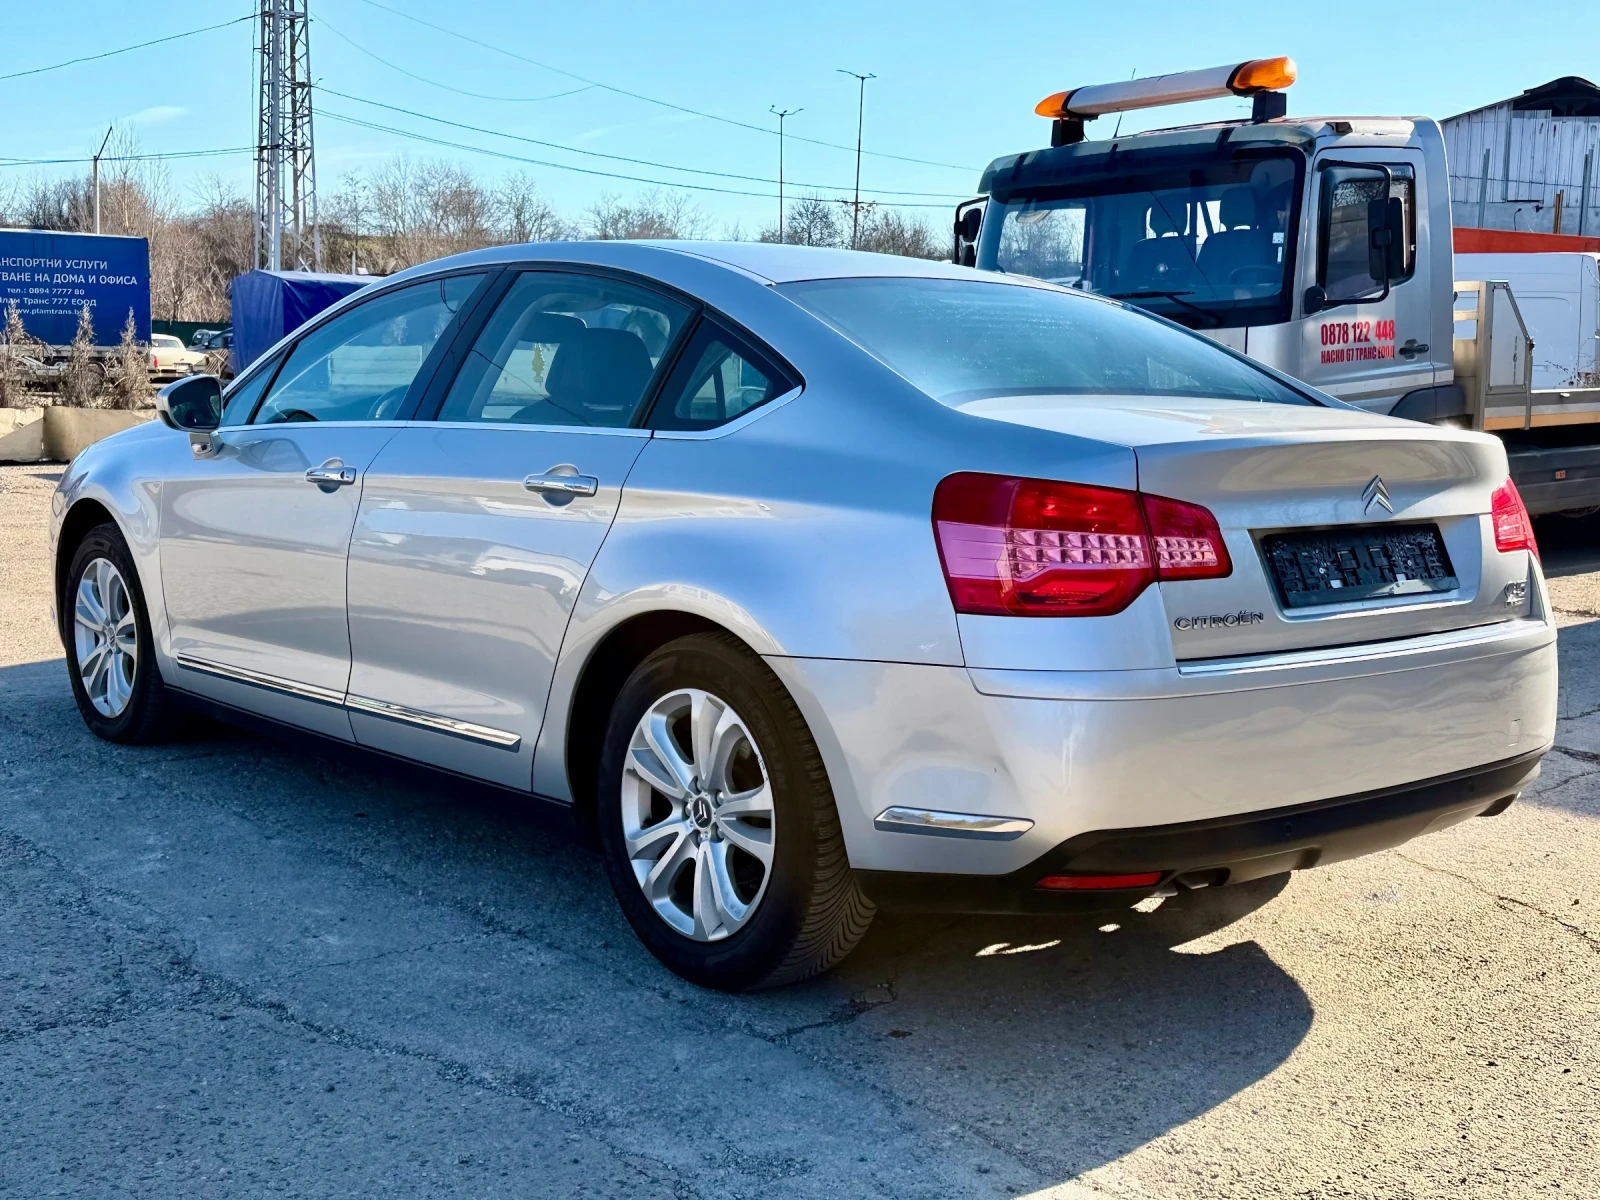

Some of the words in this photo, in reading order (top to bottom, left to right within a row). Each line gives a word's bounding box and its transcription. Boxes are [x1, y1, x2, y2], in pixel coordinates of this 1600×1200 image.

[0, 257, 62, 268] НСПОРТНИ
[65, 259, 108, 270] УСЛУГИ
[34, 273, 50, 282] НА
[53, 274, 85, 284] ДОМА
[88, 275, 96, 284] И
[99, 275, 138, 285] ОФИСА
[29, 287, 50, 295] 0894
[23, 297, 49, 305] Транс
[71, 298, 97, 306] ЕООД
[1321, 323, 1349, 346] 0878
[1351, 321, 1371, 343] 122
[1375, 319, 1395, 341] 448
[1321, 349, 1345, 364] НАСКО
[1355, 346, 1377, 361] ТРАНС
[1378, 345, 1395, 360] ЕООД
[1174, 609, 1264, 631] CITROËN
